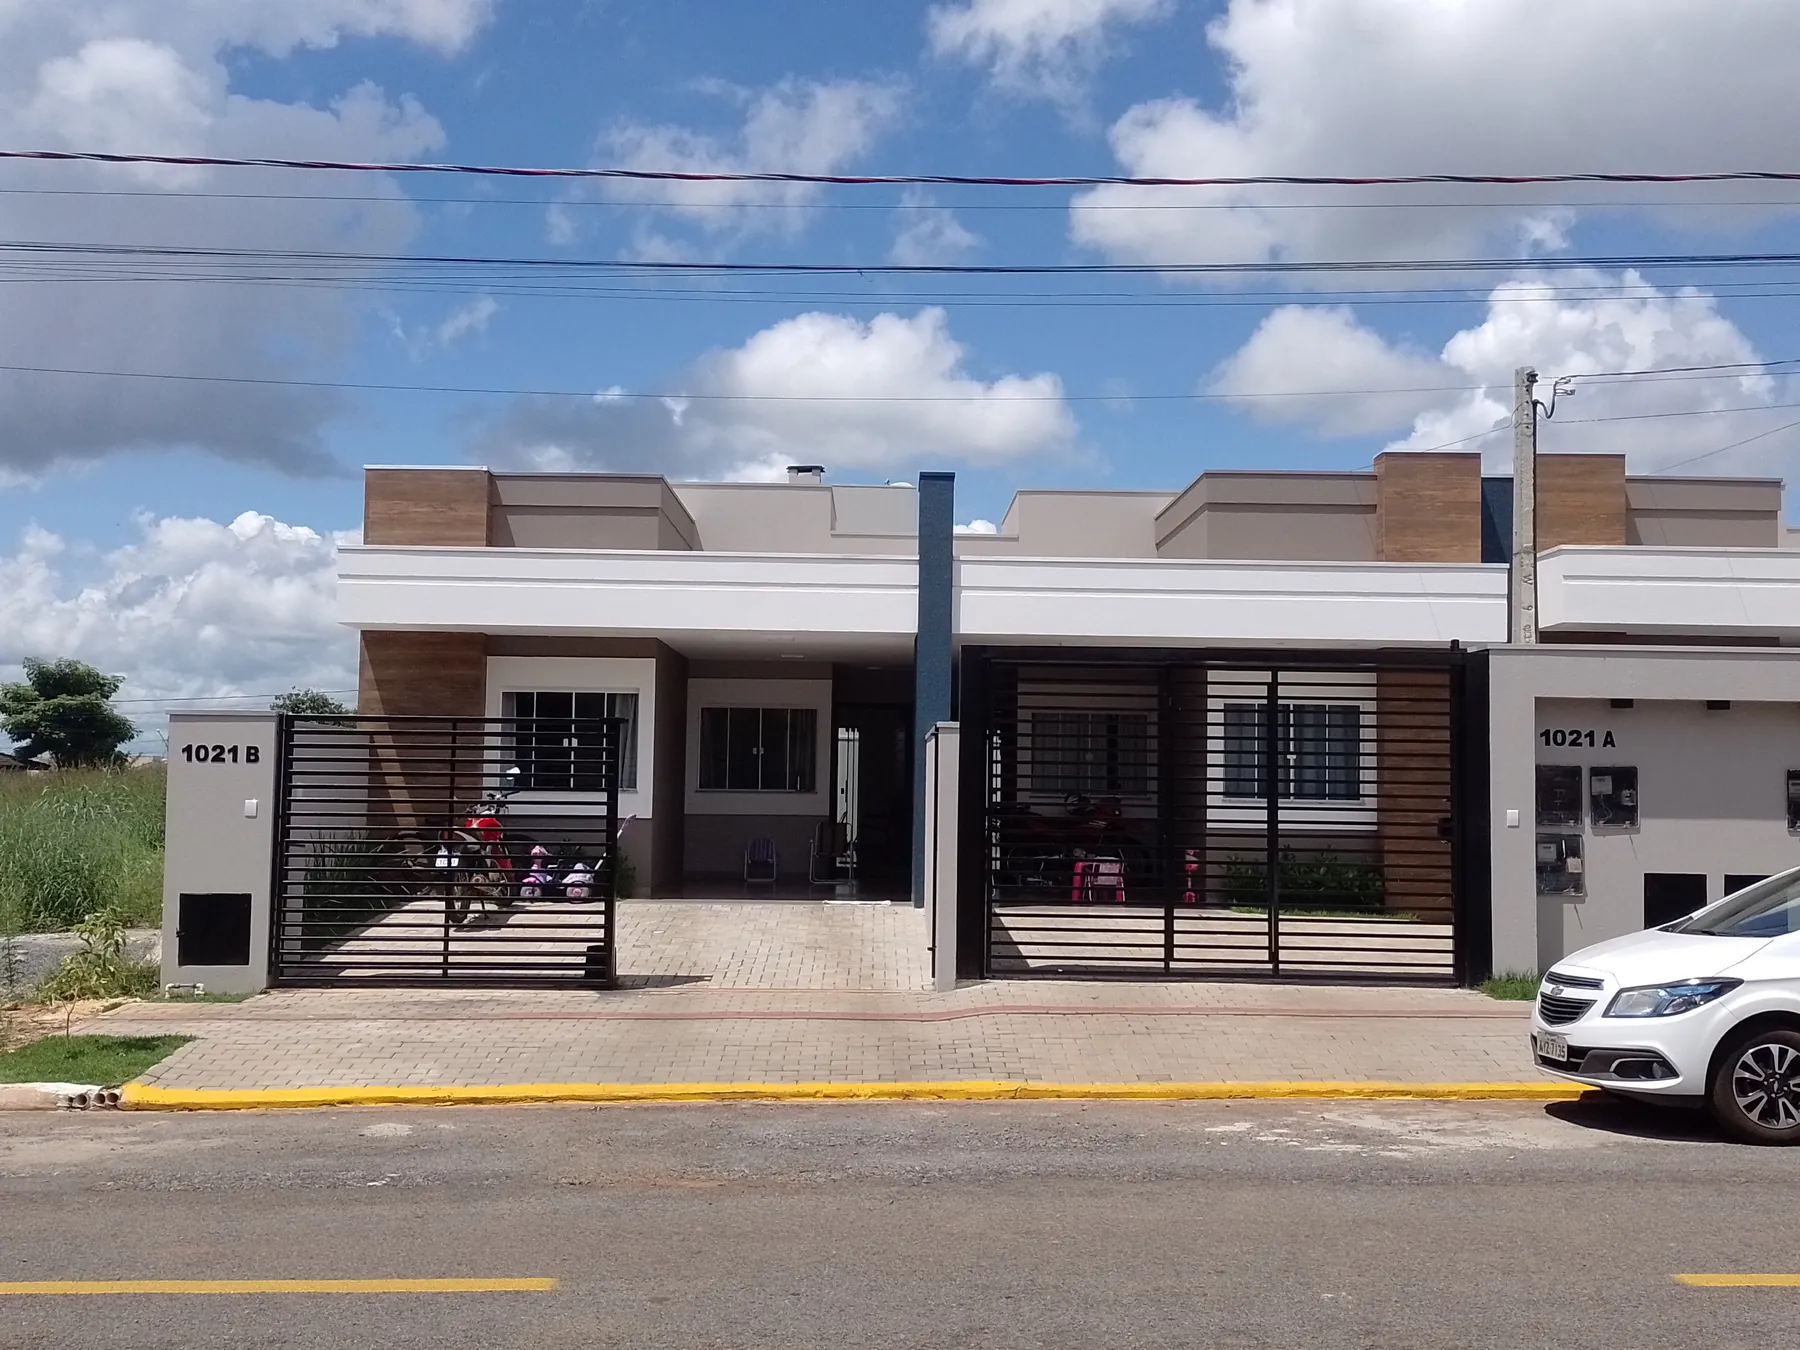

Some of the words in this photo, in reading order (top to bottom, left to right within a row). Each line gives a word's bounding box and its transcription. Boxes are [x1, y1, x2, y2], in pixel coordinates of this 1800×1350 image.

[1540, 728, 1595, 748] 1021
[1602, 730, 1616, 748] A
[181, 744, 239, 763] 1021
[246, 745, 260, 763] B
